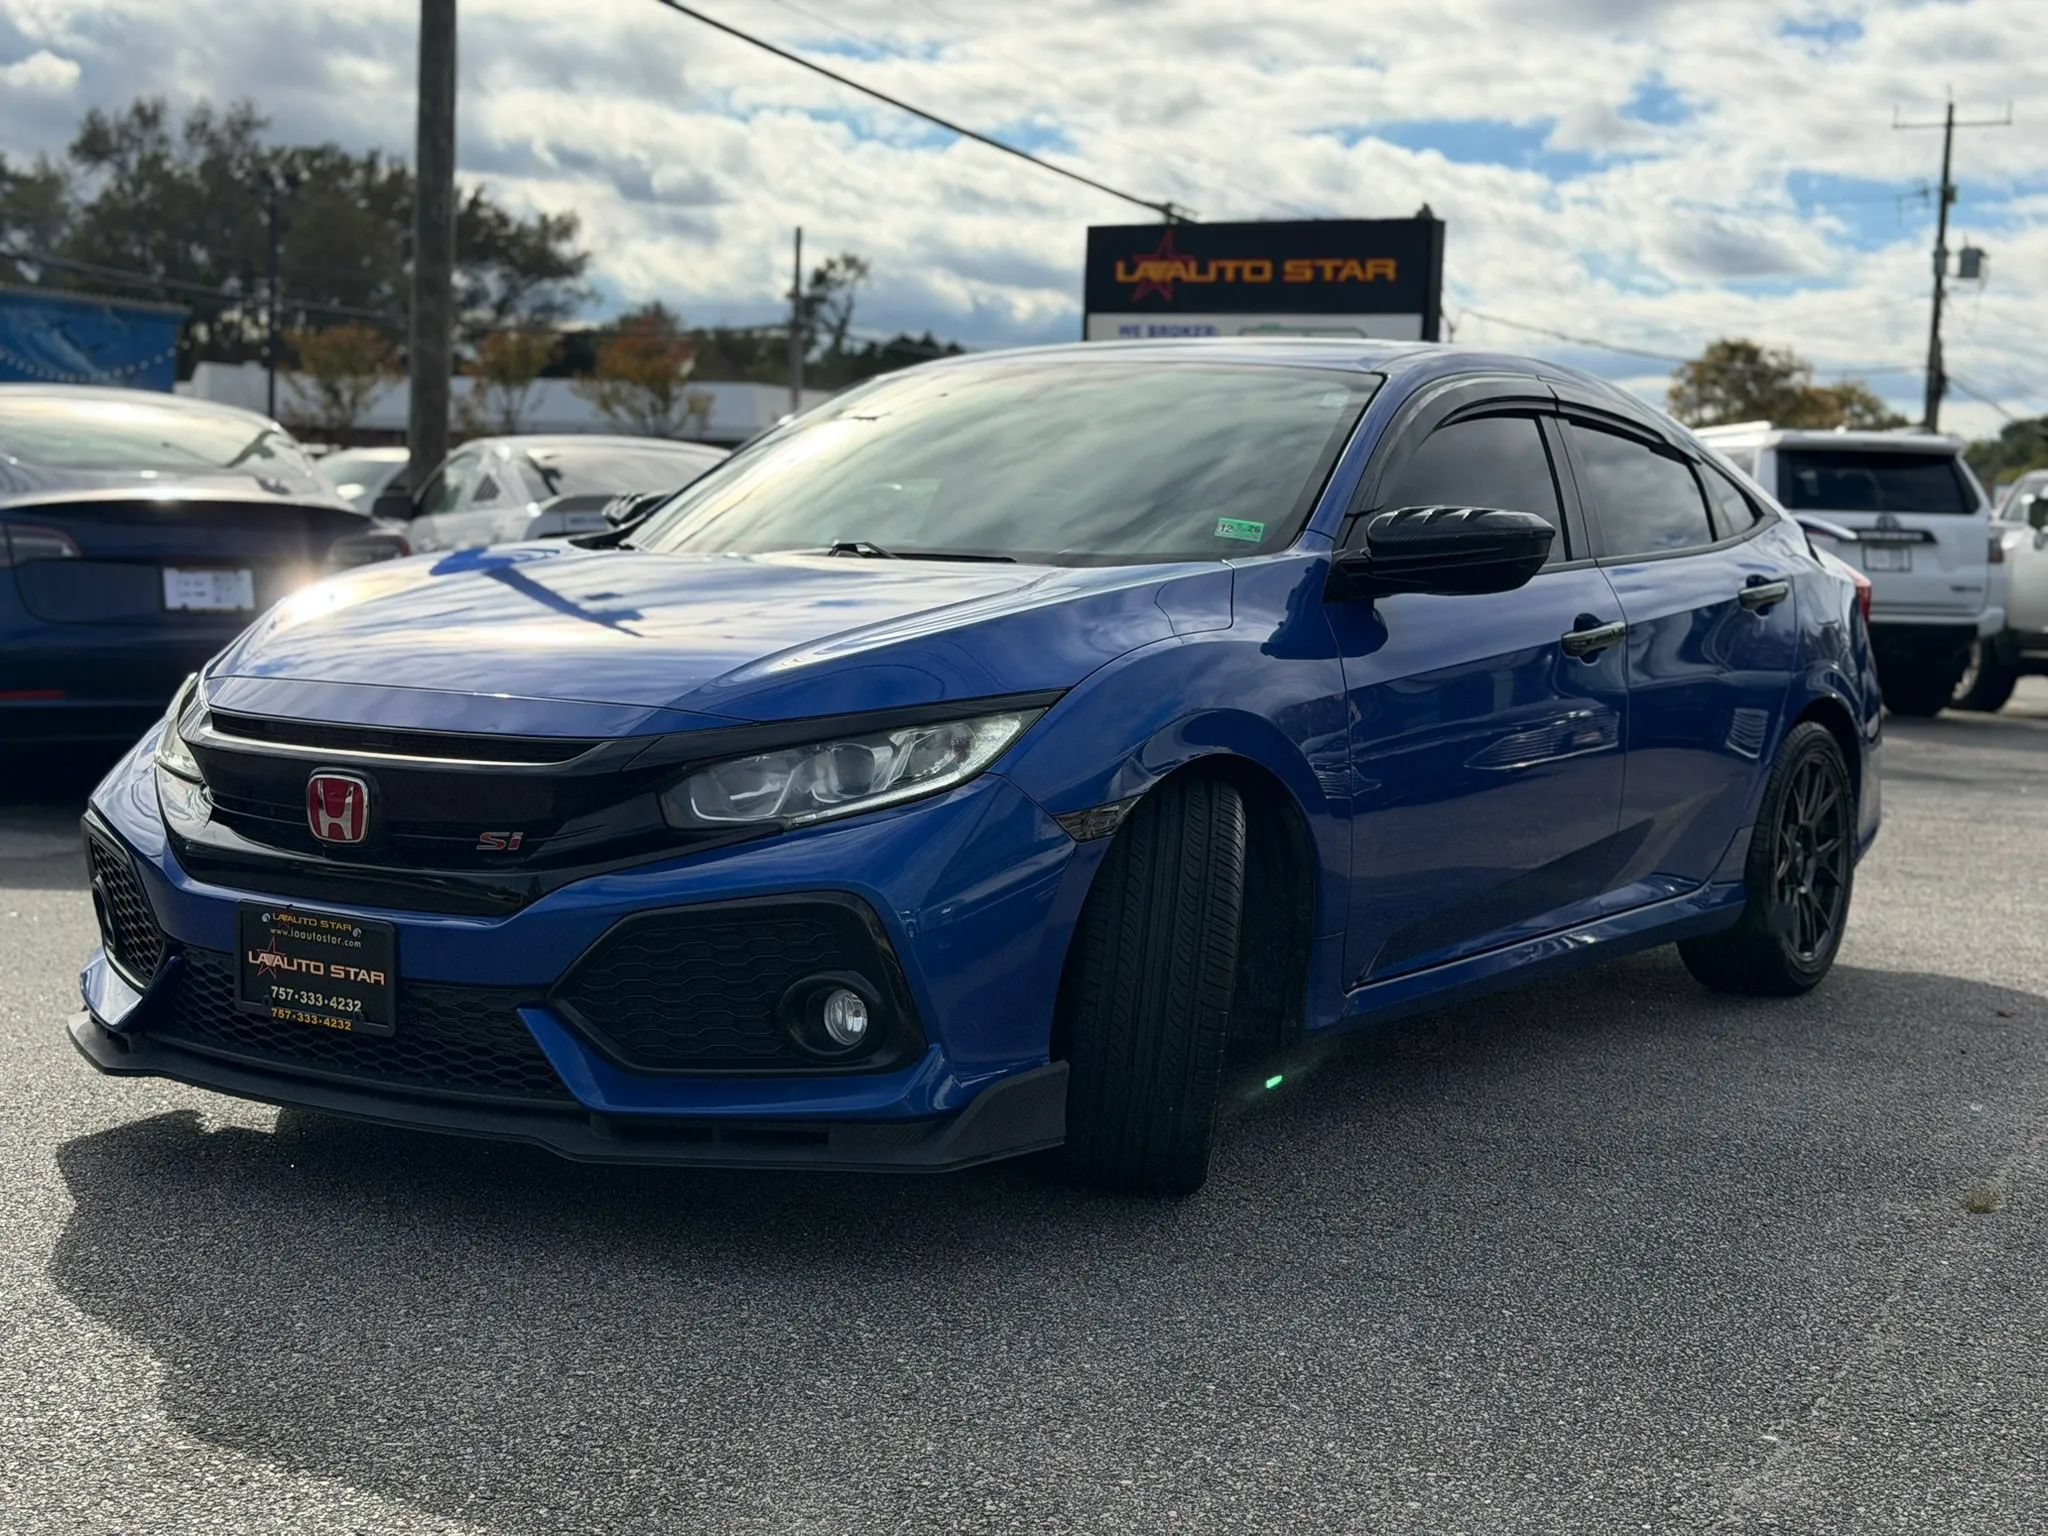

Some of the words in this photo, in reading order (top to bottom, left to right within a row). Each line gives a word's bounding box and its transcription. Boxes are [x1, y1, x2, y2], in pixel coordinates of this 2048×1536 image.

[1282, 257, 1398, 283] STAR
[476, 831, 524, 851] Si
[320, 920, 352, 932] STAR
[270, 927, 362, 949] www.laautostar.com
[330, 964, 385, 986] STAR
